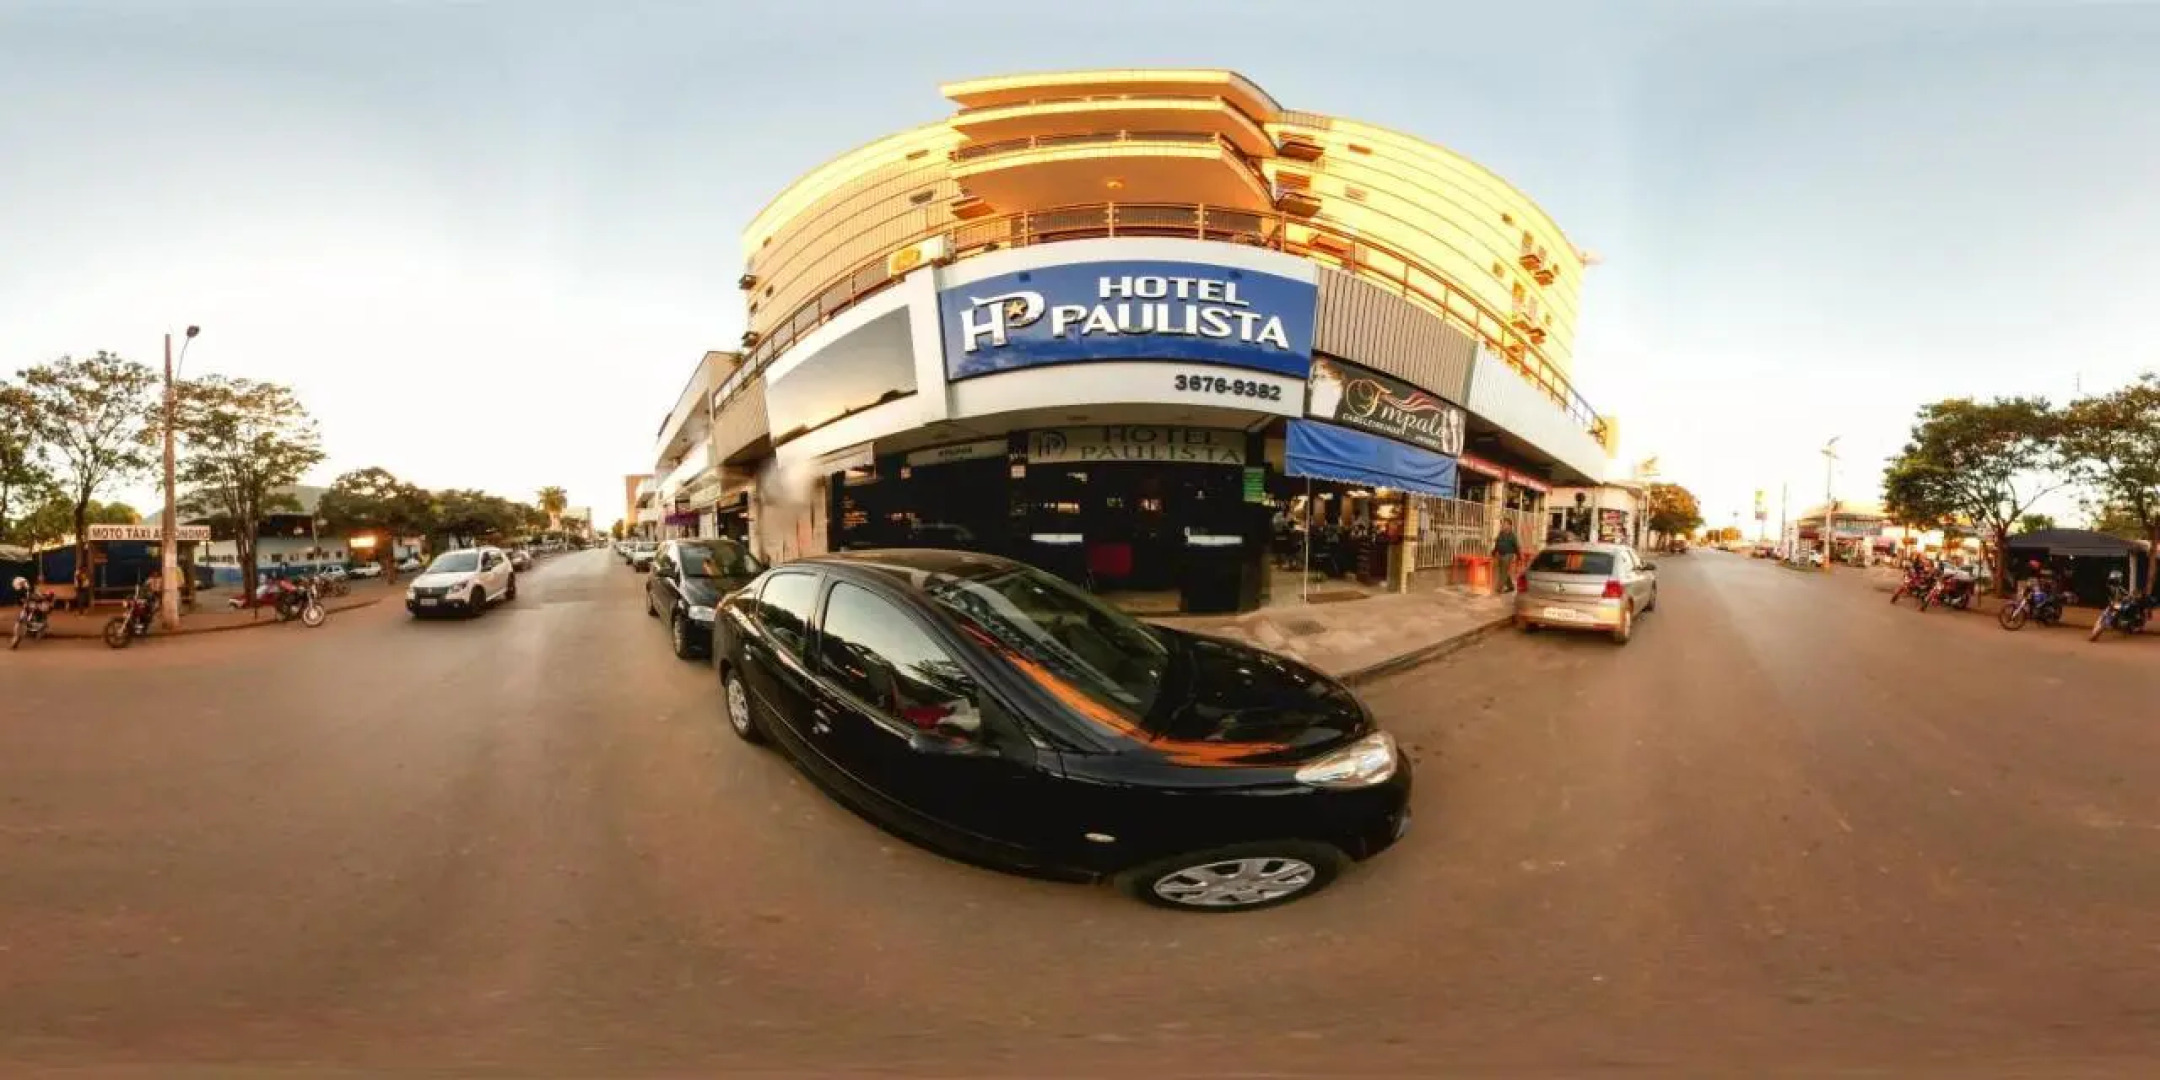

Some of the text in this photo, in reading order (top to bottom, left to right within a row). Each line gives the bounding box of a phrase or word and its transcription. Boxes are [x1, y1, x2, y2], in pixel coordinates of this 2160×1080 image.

[1099, 276, 1250, 306] HOTEL
[1052, 302, 1291, 351] PAULISTA
[1175, 374, 1282, 401] 3676-9382
[1103, 424, 1220, 446] HOTEL
[1080, 445, 1242, 463] PAULISTA
[92, 527, 123, 539] MOTO
